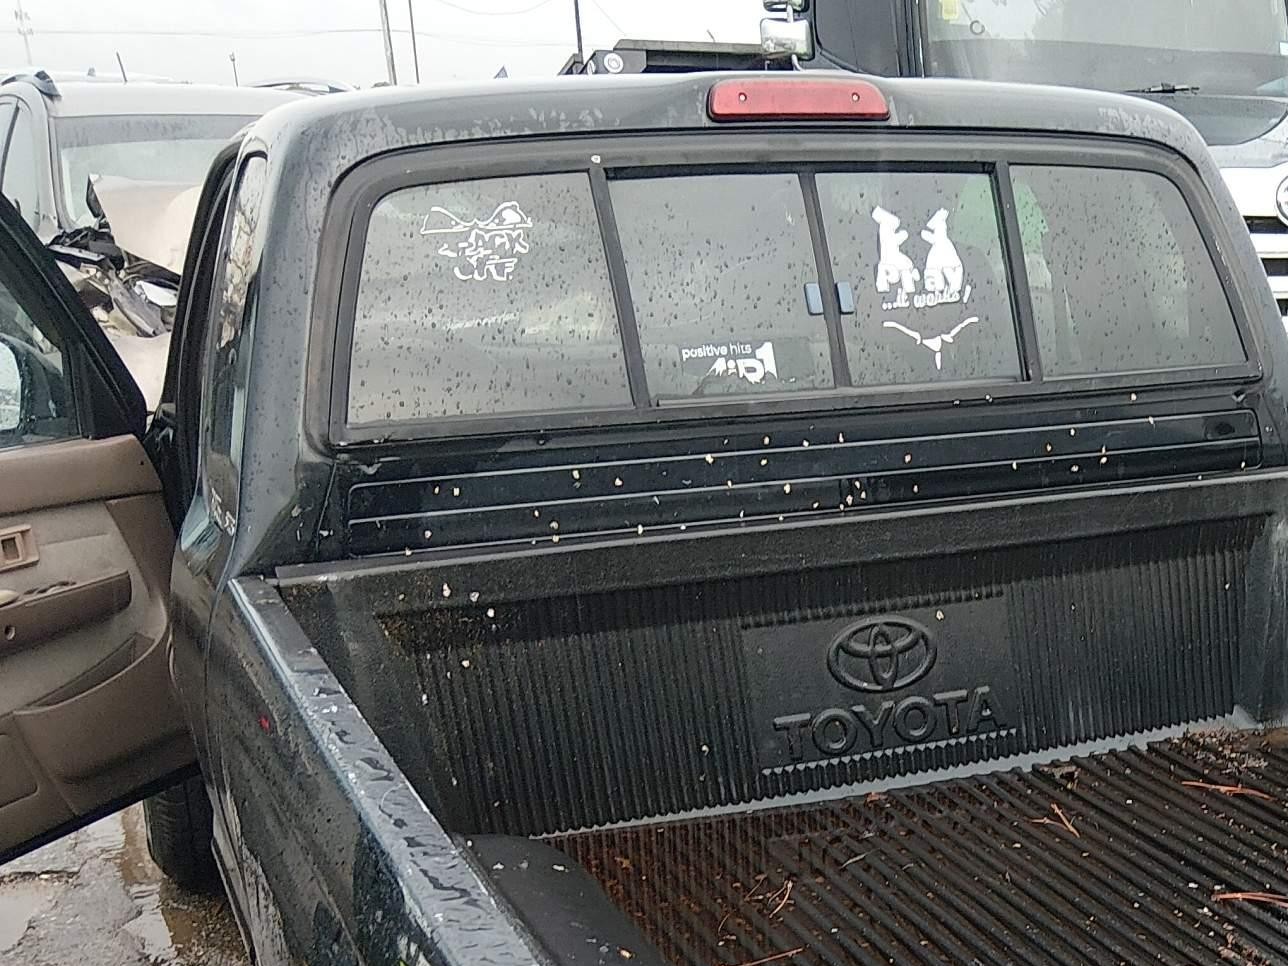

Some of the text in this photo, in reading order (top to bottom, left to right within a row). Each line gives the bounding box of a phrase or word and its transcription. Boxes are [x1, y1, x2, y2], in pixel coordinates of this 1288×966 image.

[682, 341, 752, 362] positive hits
[773, 685, 1007, 762] TOYOTA
